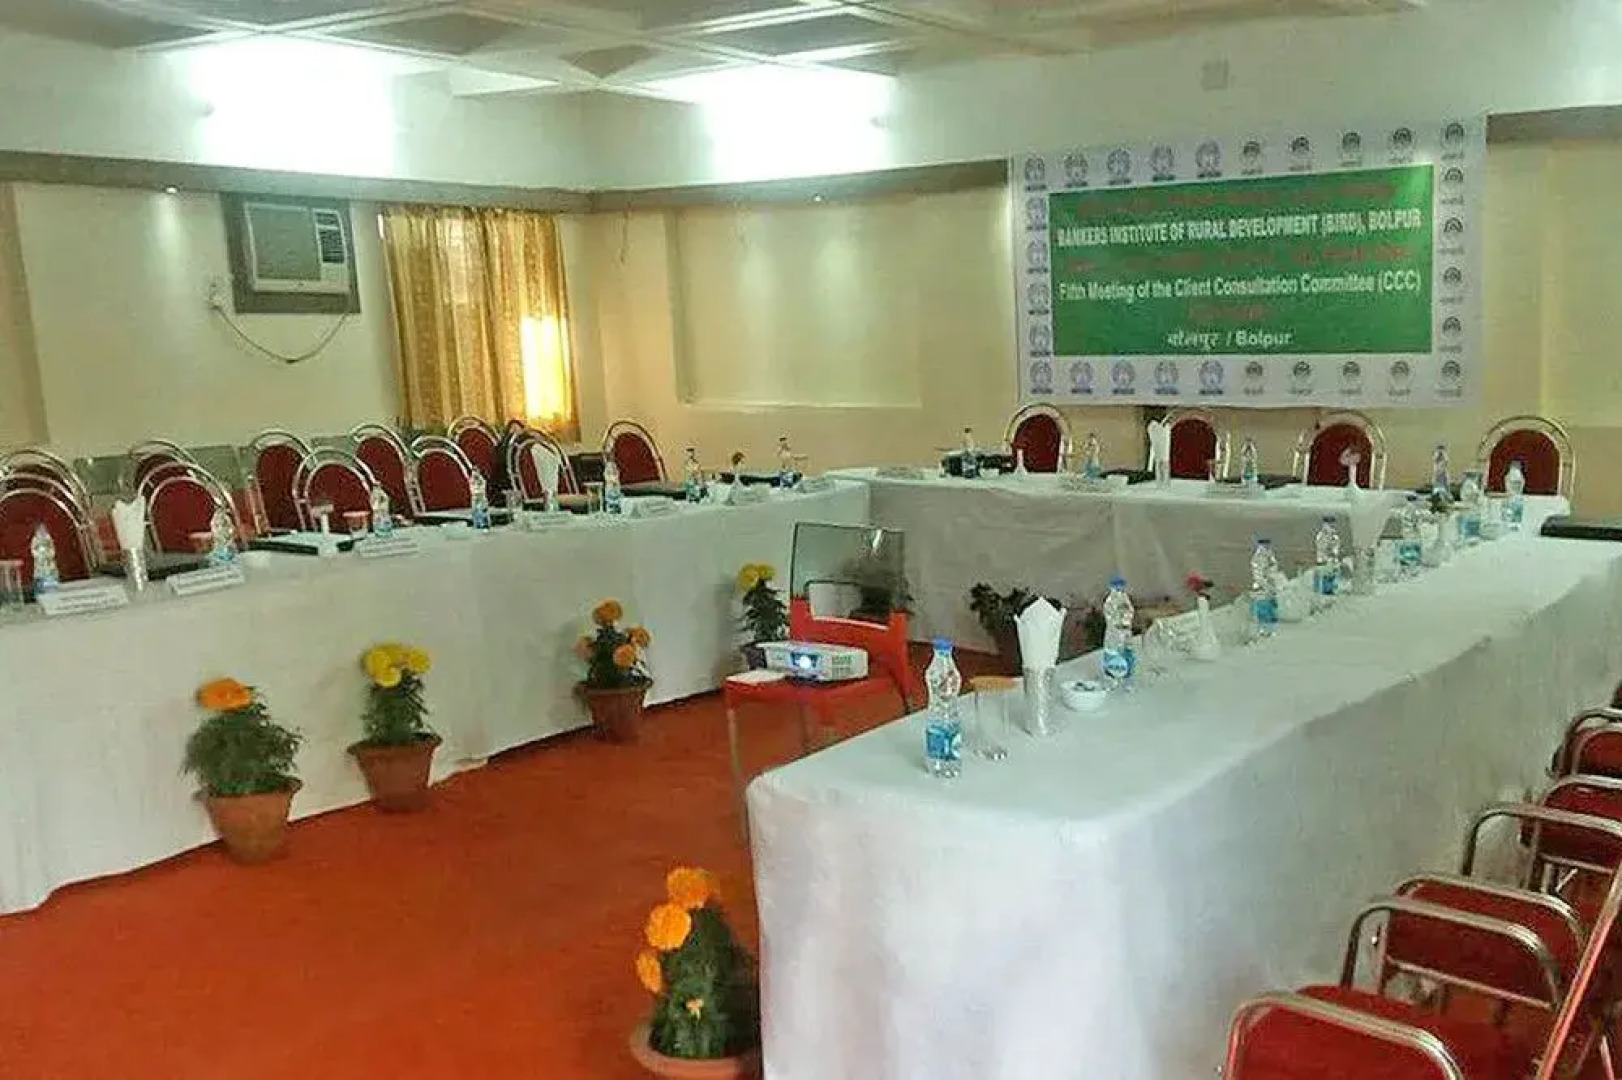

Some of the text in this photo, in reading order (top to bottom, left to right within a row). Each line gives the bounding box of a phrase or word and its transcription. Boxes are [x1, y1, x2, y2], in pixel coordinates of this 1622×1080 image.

[1110, 223, 1167, 244] INSTITUTE
[1170, 221, 1185, 241] OF
[1187, 219, 1227, 240] RURAL
[1228, 213, 1318, 238] DEVELOPMENT
[1368, 208, 1422, 231] BOLPUR
[1087, 278, 1135, 303] Meeting
[1136, 279, 1150, 298] of
[1152, 279, 1172, 298] the
[1214, 273, 1298, 296] Consultation
[1300, 271, 1375, 293] Committee
[1378, 269, 1421, 293] (CCC)
[1235, 329, 1293, 348] Bolpur
